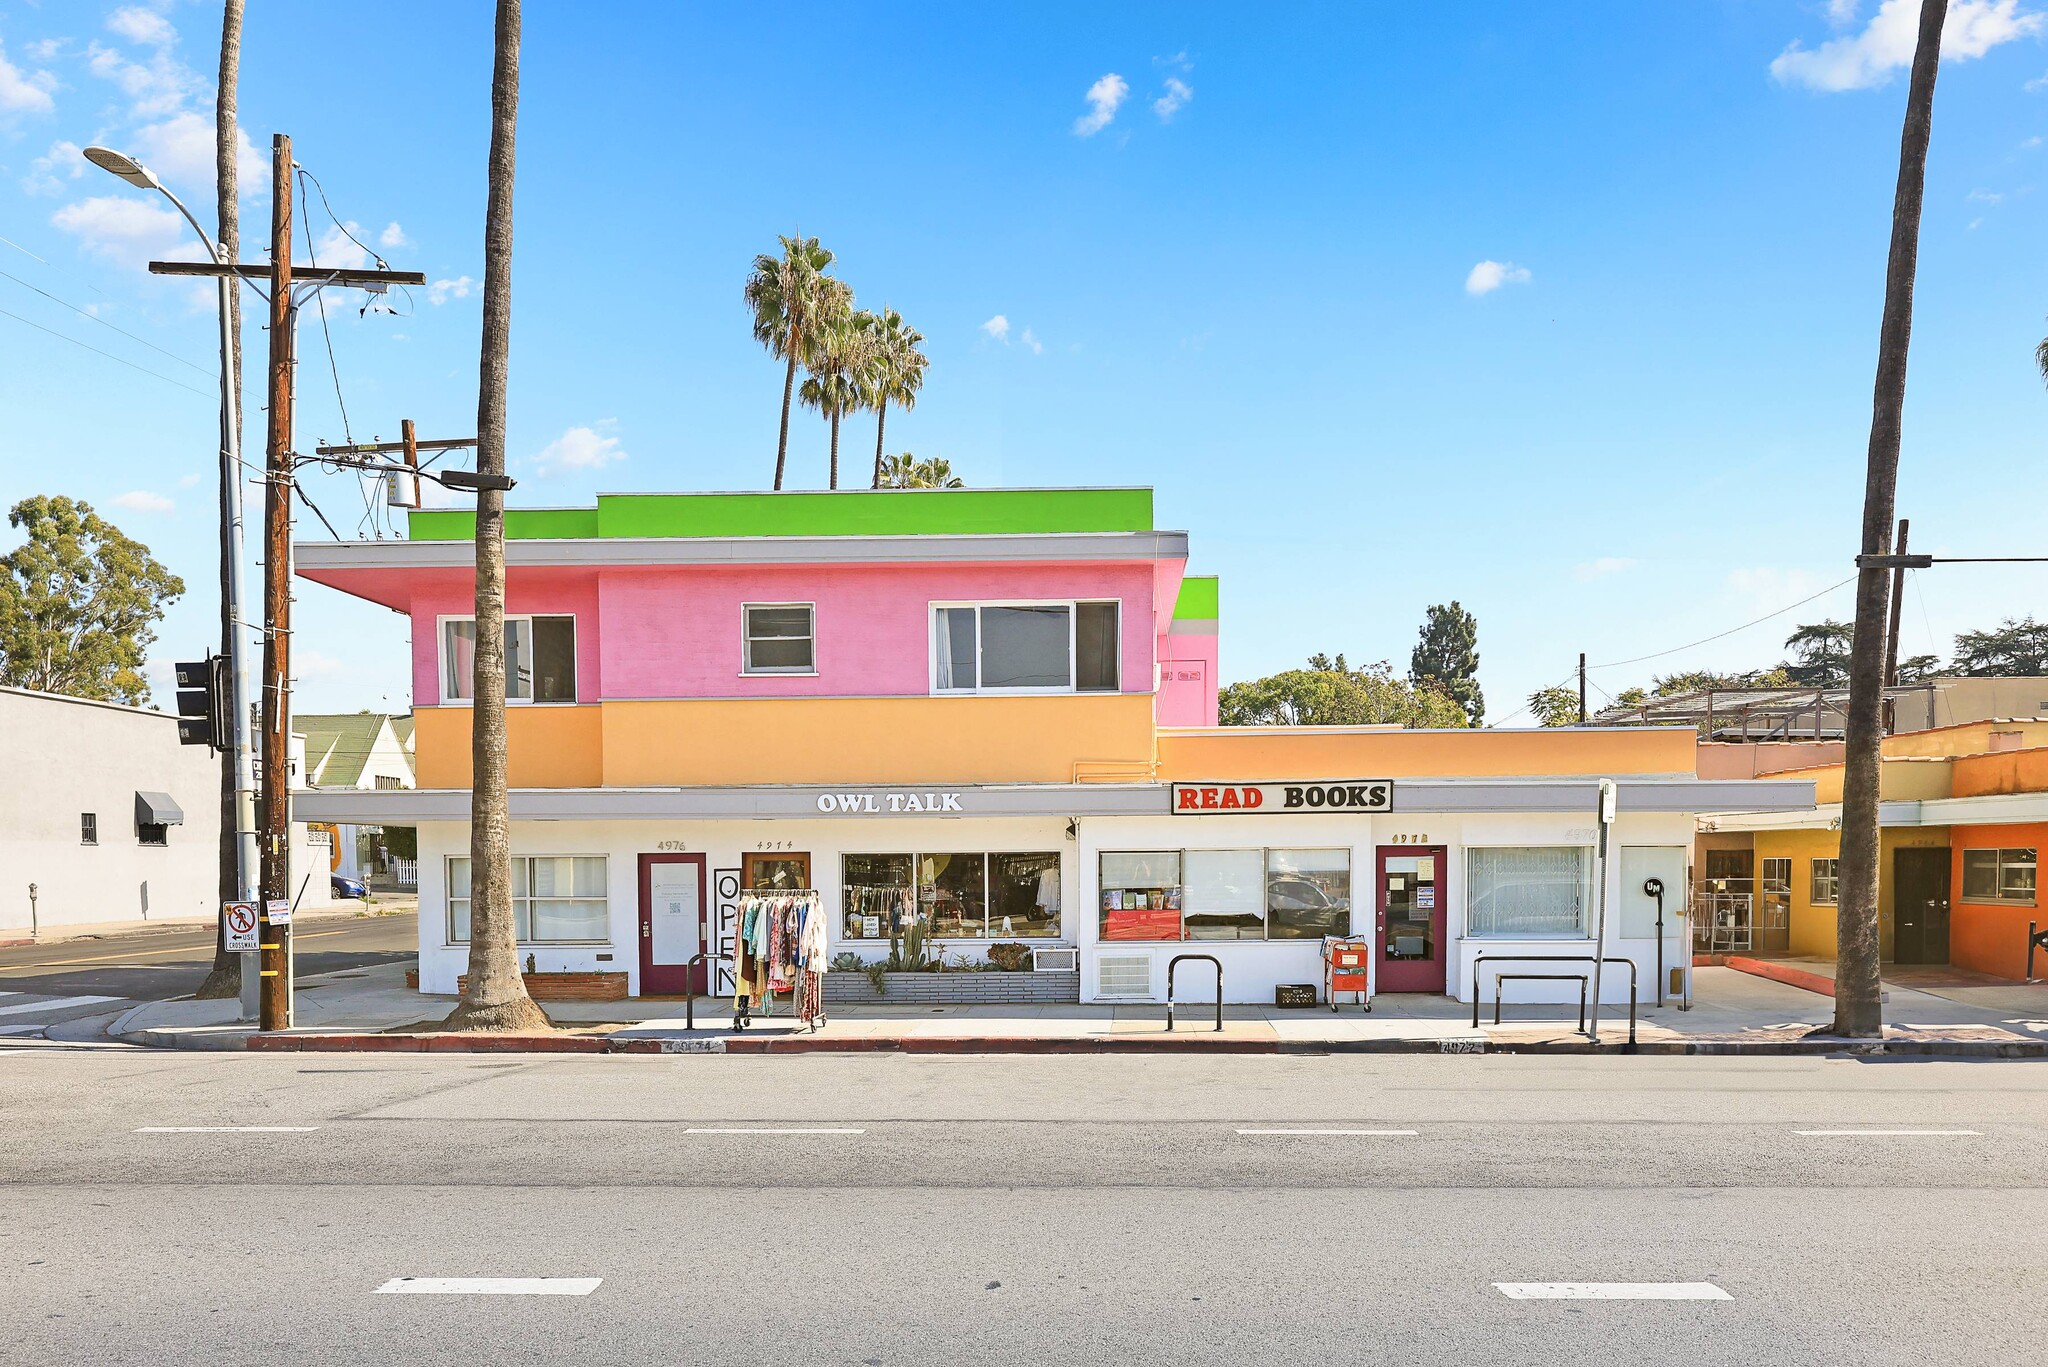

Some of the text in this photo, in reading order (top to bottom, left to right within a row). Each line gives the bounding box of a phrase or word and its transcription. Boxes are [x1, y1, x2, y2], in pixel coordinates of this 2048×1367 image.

[817, 793, 963, 812] OWL TALK
[1178, 786, 1387, 809] READ BOOKS
[657, 840, 686, 851] 4976
